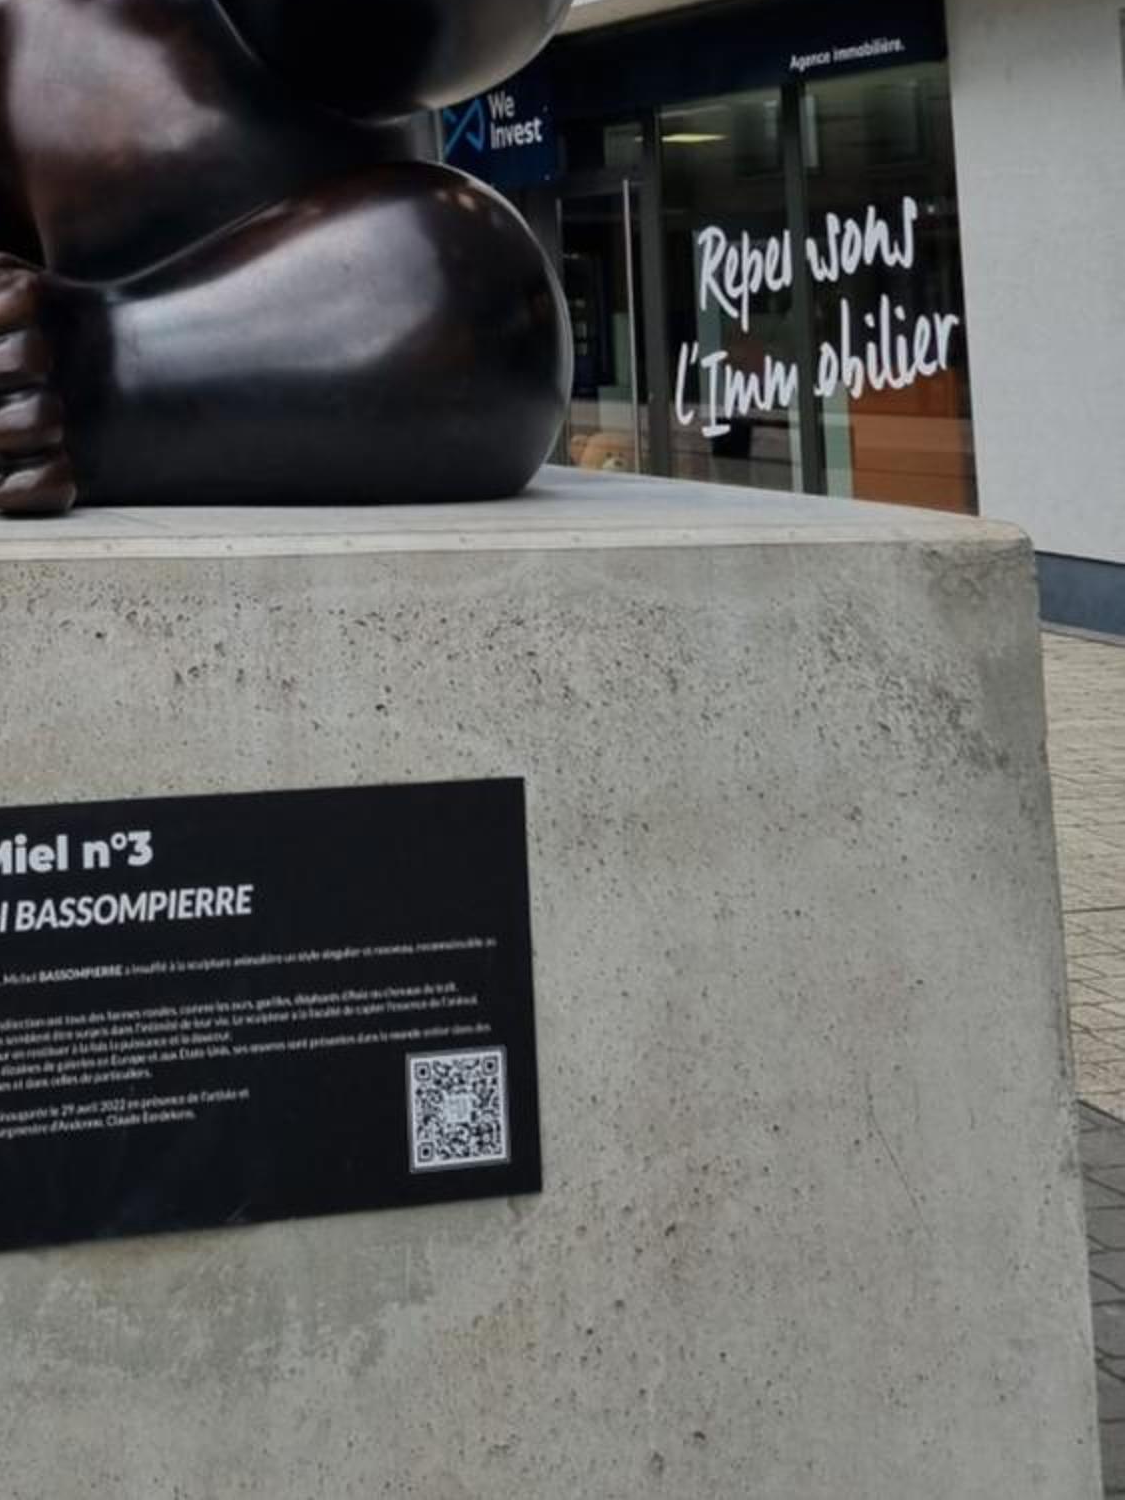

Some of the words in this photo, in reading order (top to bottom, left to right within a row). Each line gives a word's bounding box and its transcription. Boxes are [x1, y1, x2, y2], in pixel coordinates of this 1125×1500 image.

[789, 52, 831, 73] Agence
[487, 90, 515, 119] We
[490, 117, 543, 149] Invest
[83, 831, 153, 869] n°3
[15, 884, 253, 931] BASSOMPIERRE
[38, 965, 122, 982] BASSOMPIERRE
